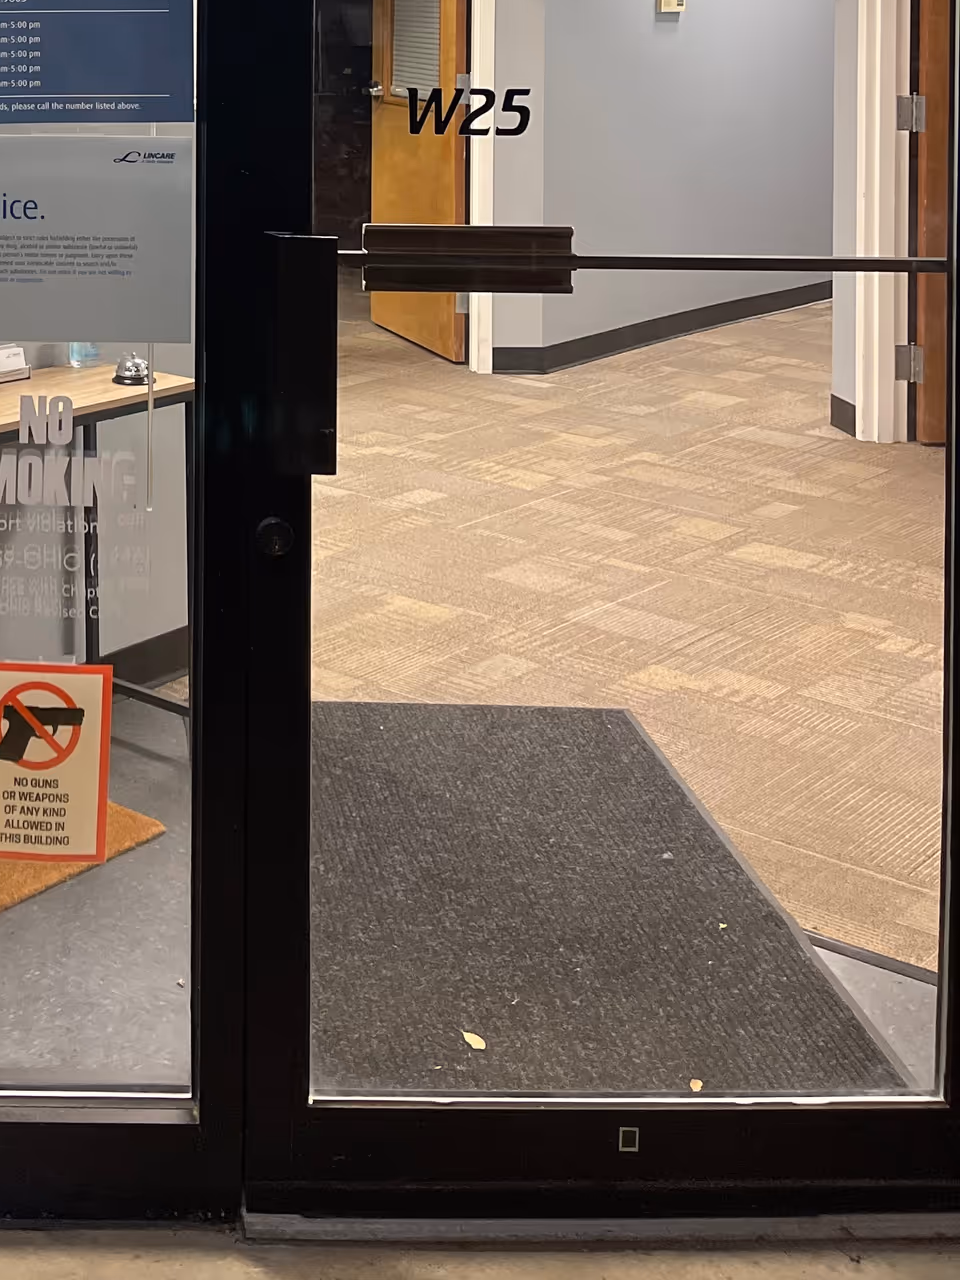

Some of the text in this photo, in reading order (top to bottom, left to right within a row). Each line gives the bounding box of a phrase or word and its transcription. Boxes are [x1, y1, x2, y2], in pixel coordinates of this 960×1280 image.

[29, 21, 40, 31] pm
[29, 36, 40, 46] pm
[29, 50, 40, 60] pm
[29, 65, 40, 75] pm
[29, 80, 40, 90] pm
[12, 103, 35, 112] please
[37, 102, 49, 110] call
[51, 102, 63, 110] the
[66, 102, 93, 110] number
[95, 102, 115, 110] listed
[406, 88, 531, 137] W25
[143, 152, 176, 160] LINCARE
[19, 395, 74, 445] NO
[14, 777, 59, 789] NO GUNS
[2, 790, 70, 804] OR WEAPONS
[4, 804, 66, 818] OF ANY KIND
[4, 819, 65, 832] ALLOWED IN
[0, 832, 70, 847] THIS BUILDING
